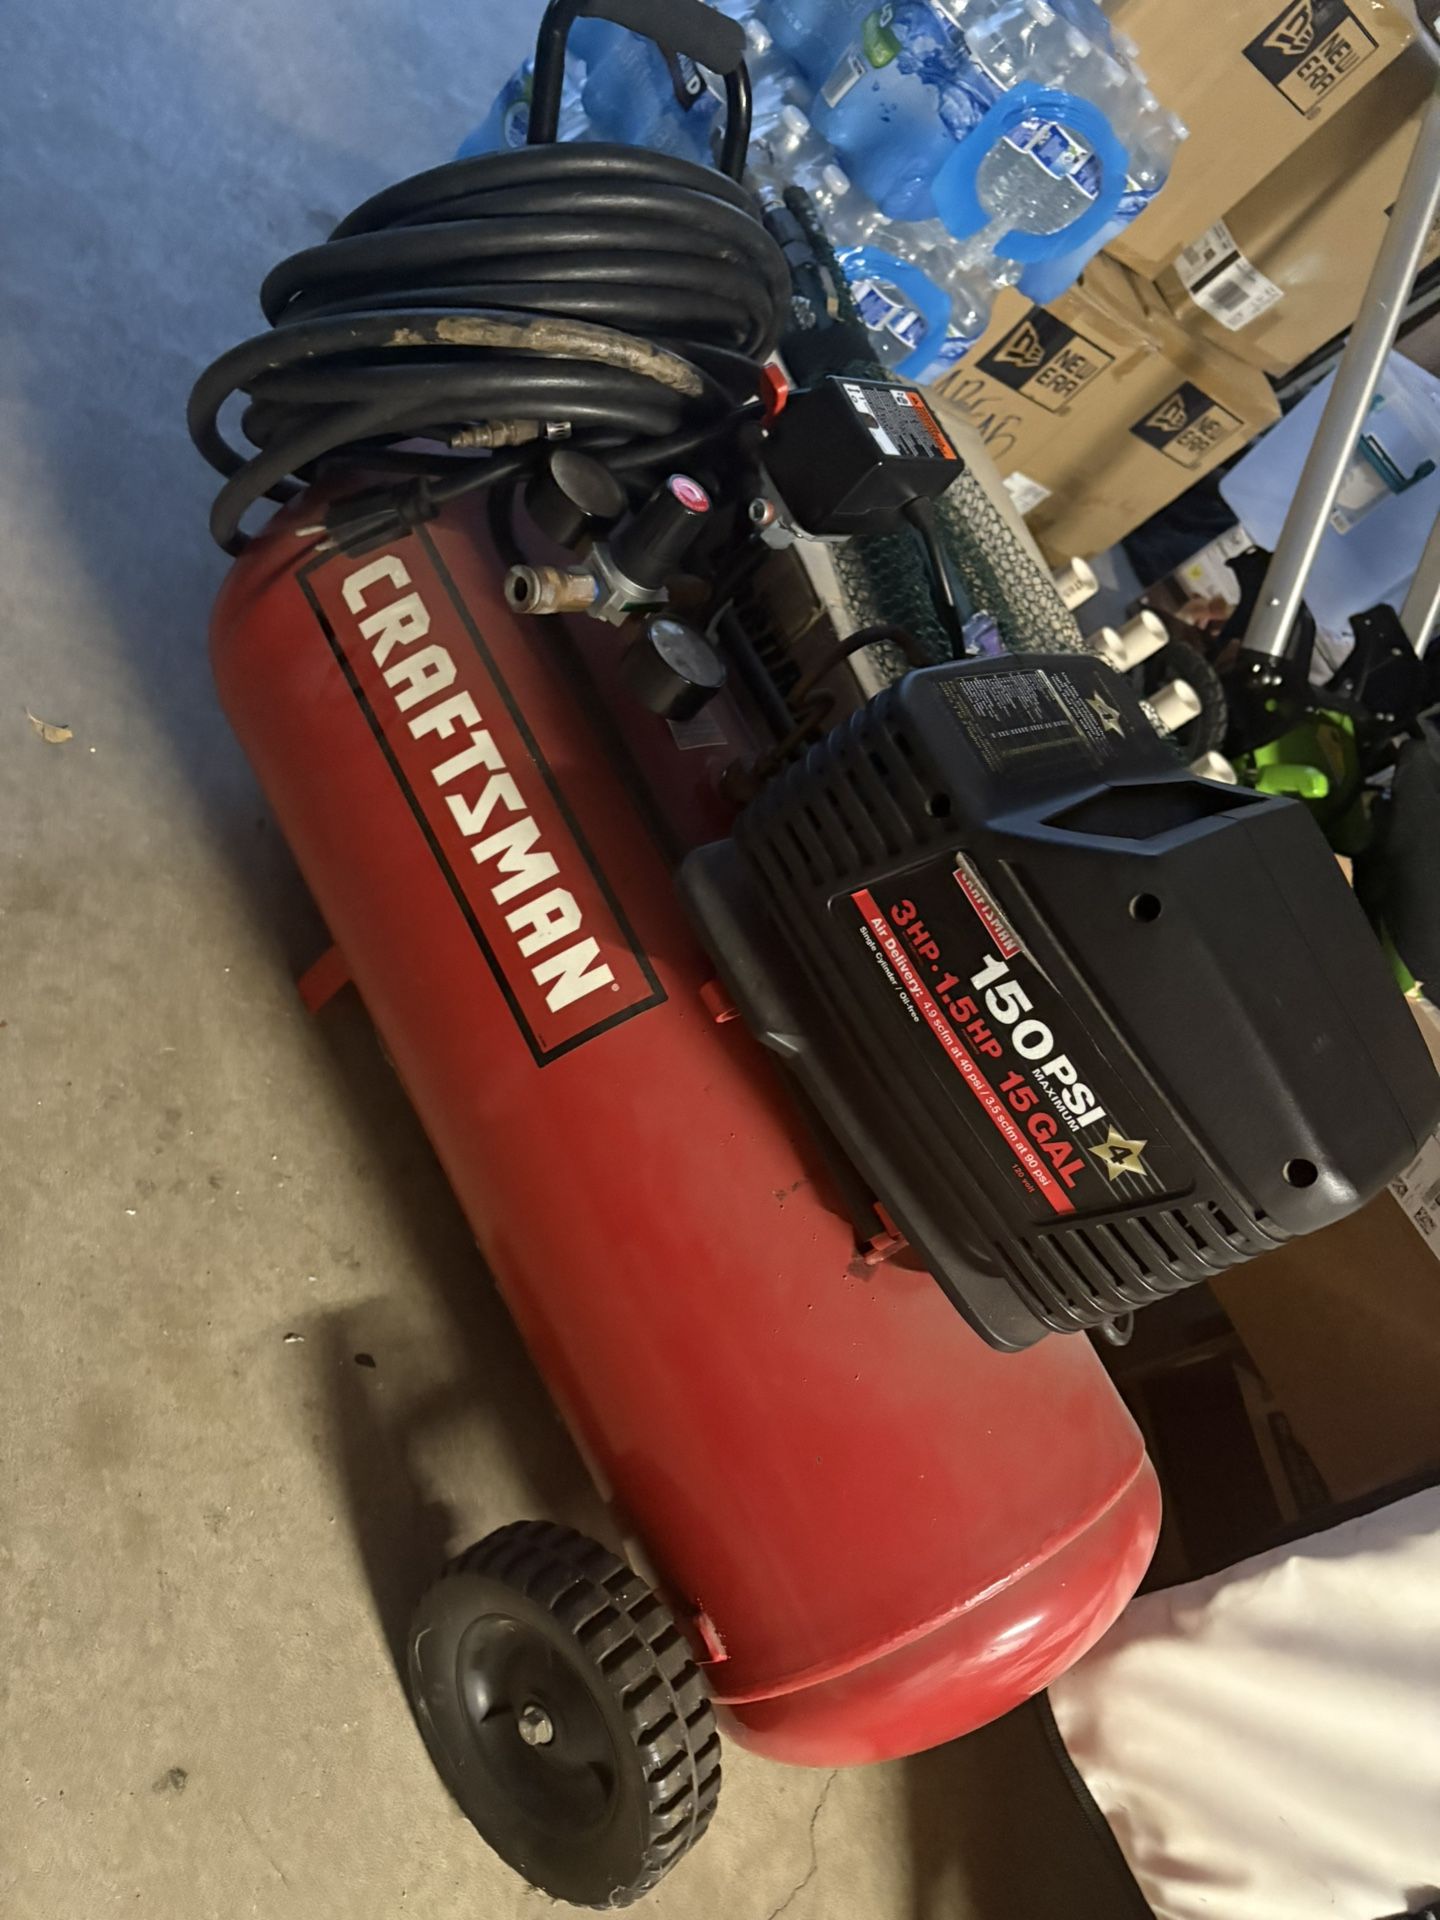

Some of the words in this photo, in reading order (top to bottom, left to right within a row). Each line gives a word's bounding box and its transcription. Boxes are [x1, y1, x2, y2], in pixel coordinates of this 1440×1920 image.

[1319, 32, 1360, 73] NEW
[1297, 55, 1336, 96] ERA
[1036, 367, 1077, 397] ERA
[1055, 349, 1098, 380] NEW
[342, 554, 615, 1014] CRAFTSMAN
[860, 926, 877, 952] Single
[875, 952, 898, 986] Cylinder
[899, 992, 920, 1023] Oil-free
[871, 918, 888, 937] Air
[885, 937, 924, 998] Delivery:
[923, 1001, 937, 1018] 4.9
[933, 1019, 953, 1045] scfm
[950, 1045, 963, 1059] at
[959, 1058, 973, 1073] 40
[968, 1072, 983, 1090] psi
[985, 1096, 1001, 1114] 3.5
[997, 1113, 1018, 1141] scfm
[1015, 1141, 1028, 1155] at
[1024, 1153, 1039, 1169] 90
[1033, 1167, 1052, 1187] psi
[1032, 1067, 1080, 1133] MAXIMUM
[1107, 1144, 1133, 1165] 4
[1012, 1163, 1025, 1178] 120
[1022, 1177, 1036, 1194] volt
